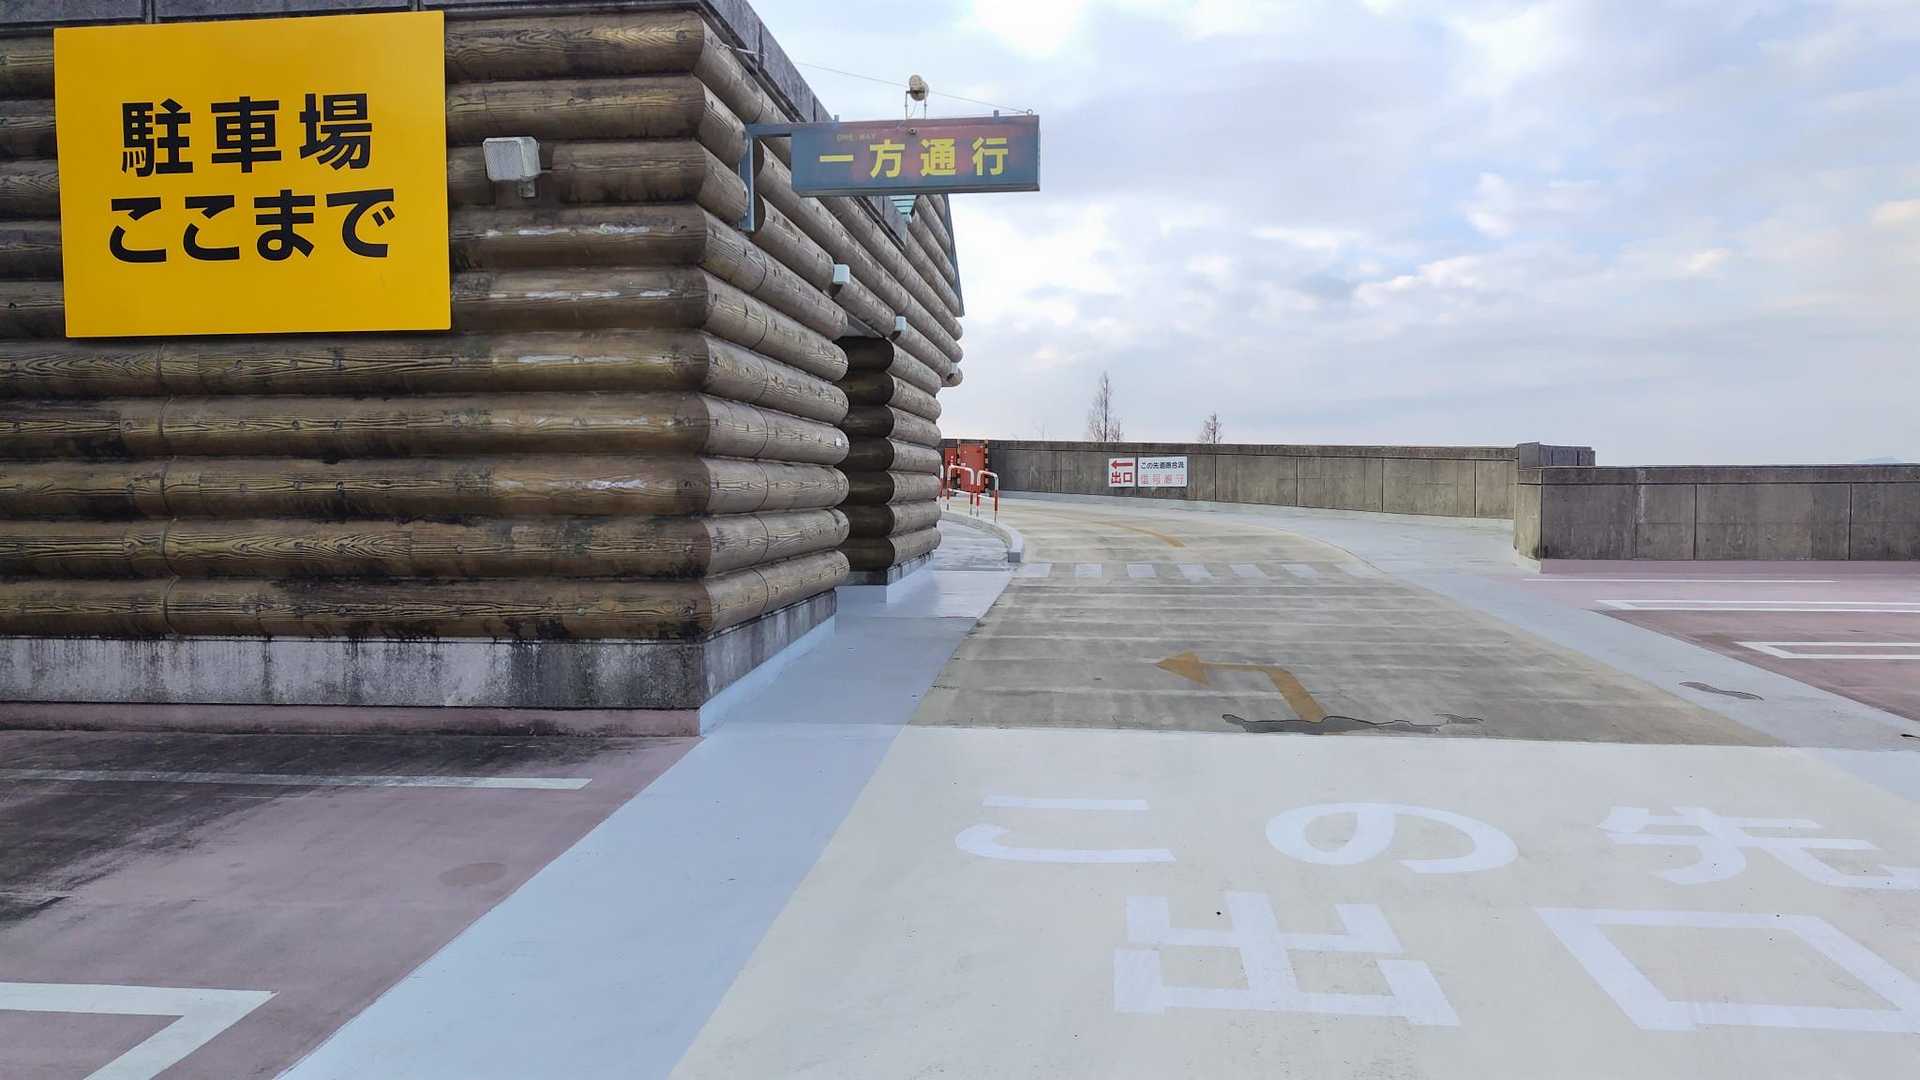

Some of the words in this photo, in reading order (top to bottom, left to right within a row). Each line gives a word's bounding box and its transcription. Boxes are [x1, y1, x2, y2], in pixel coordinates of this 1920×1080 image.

[121, 93, 372, 177] 駐車場
[819, 137, 1008, 178] 一方通行
[109, 188, 395, 263] ここまで
[1111, 471, 1133, 484] 出口
[1113, 891, 1920, 1034] 出口
